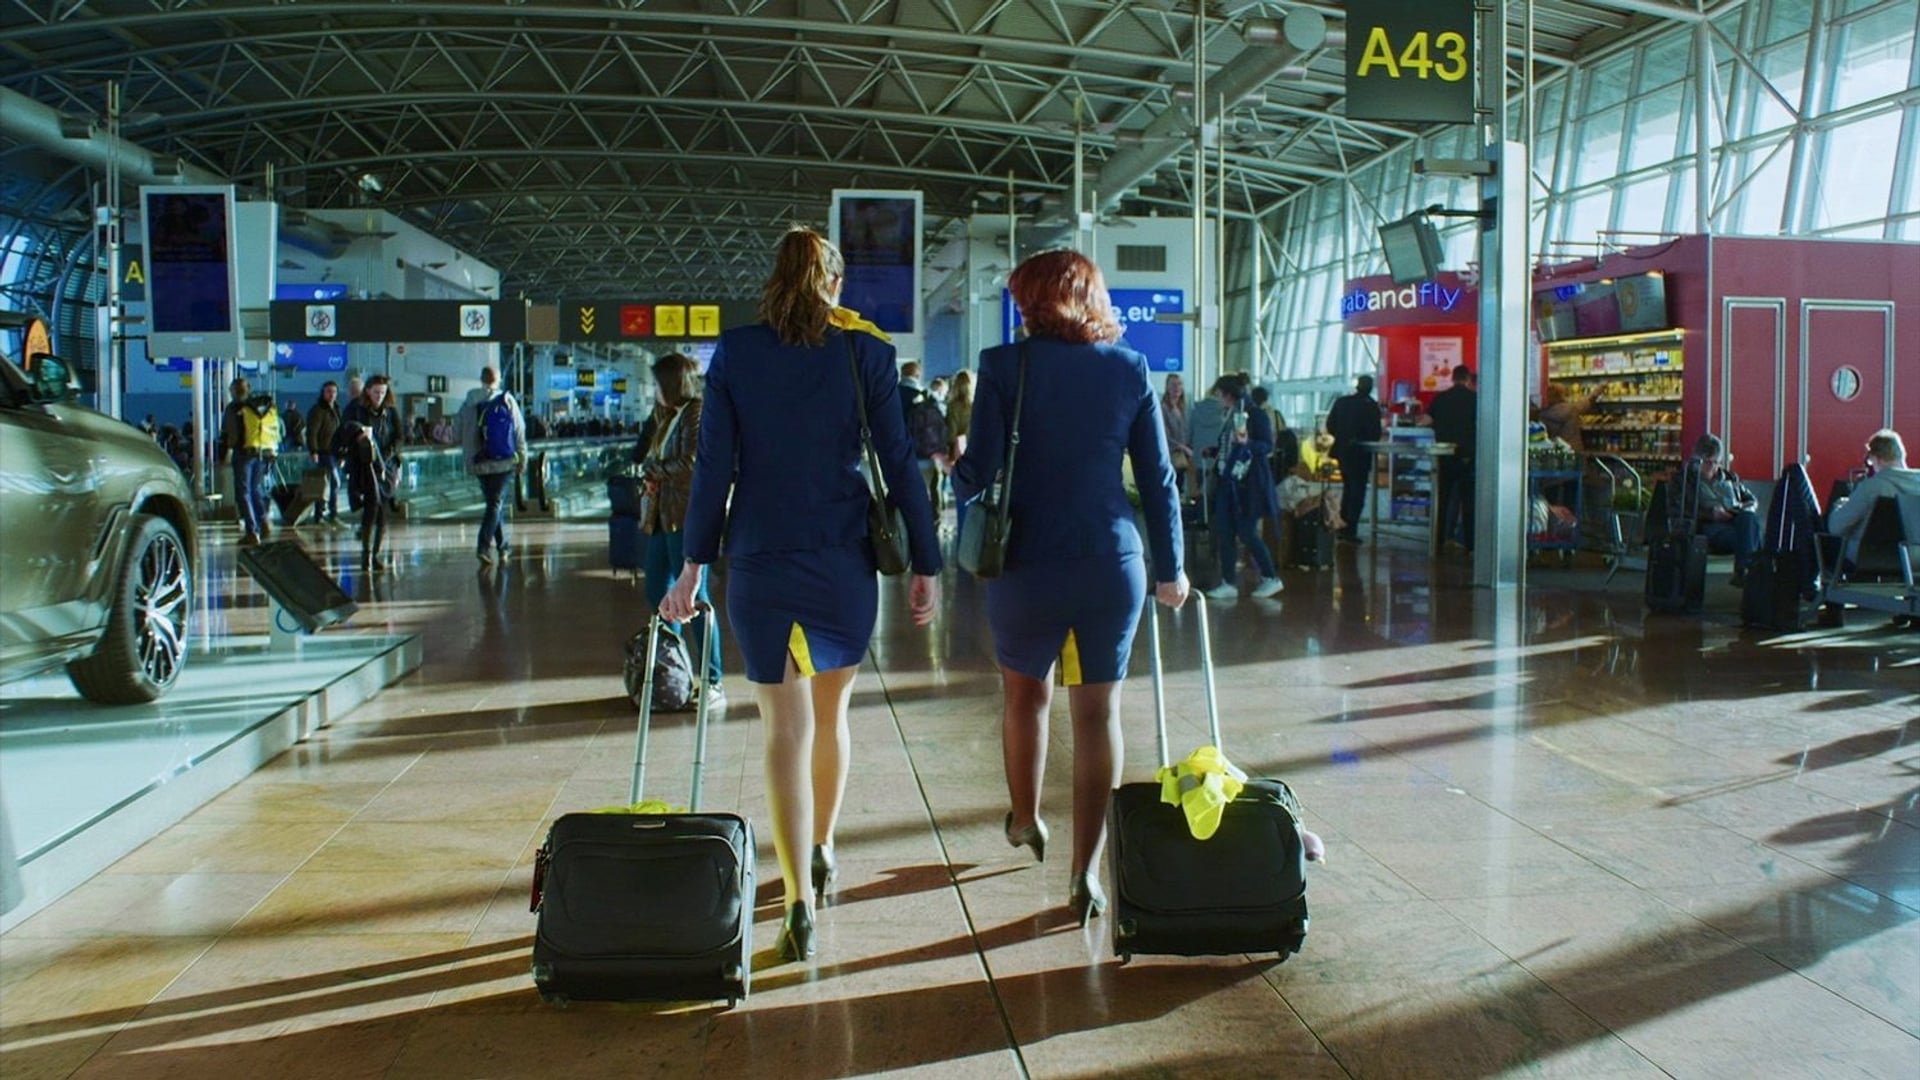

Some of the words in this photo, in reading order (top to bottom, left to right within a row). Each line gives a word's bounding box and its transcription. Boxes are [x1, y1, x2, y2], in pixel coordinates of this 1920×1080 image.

[1357, 27, 1467, 81] A43
[1110, 306, 1156, 322] e.eu
[698, 316, 711, 333] T
